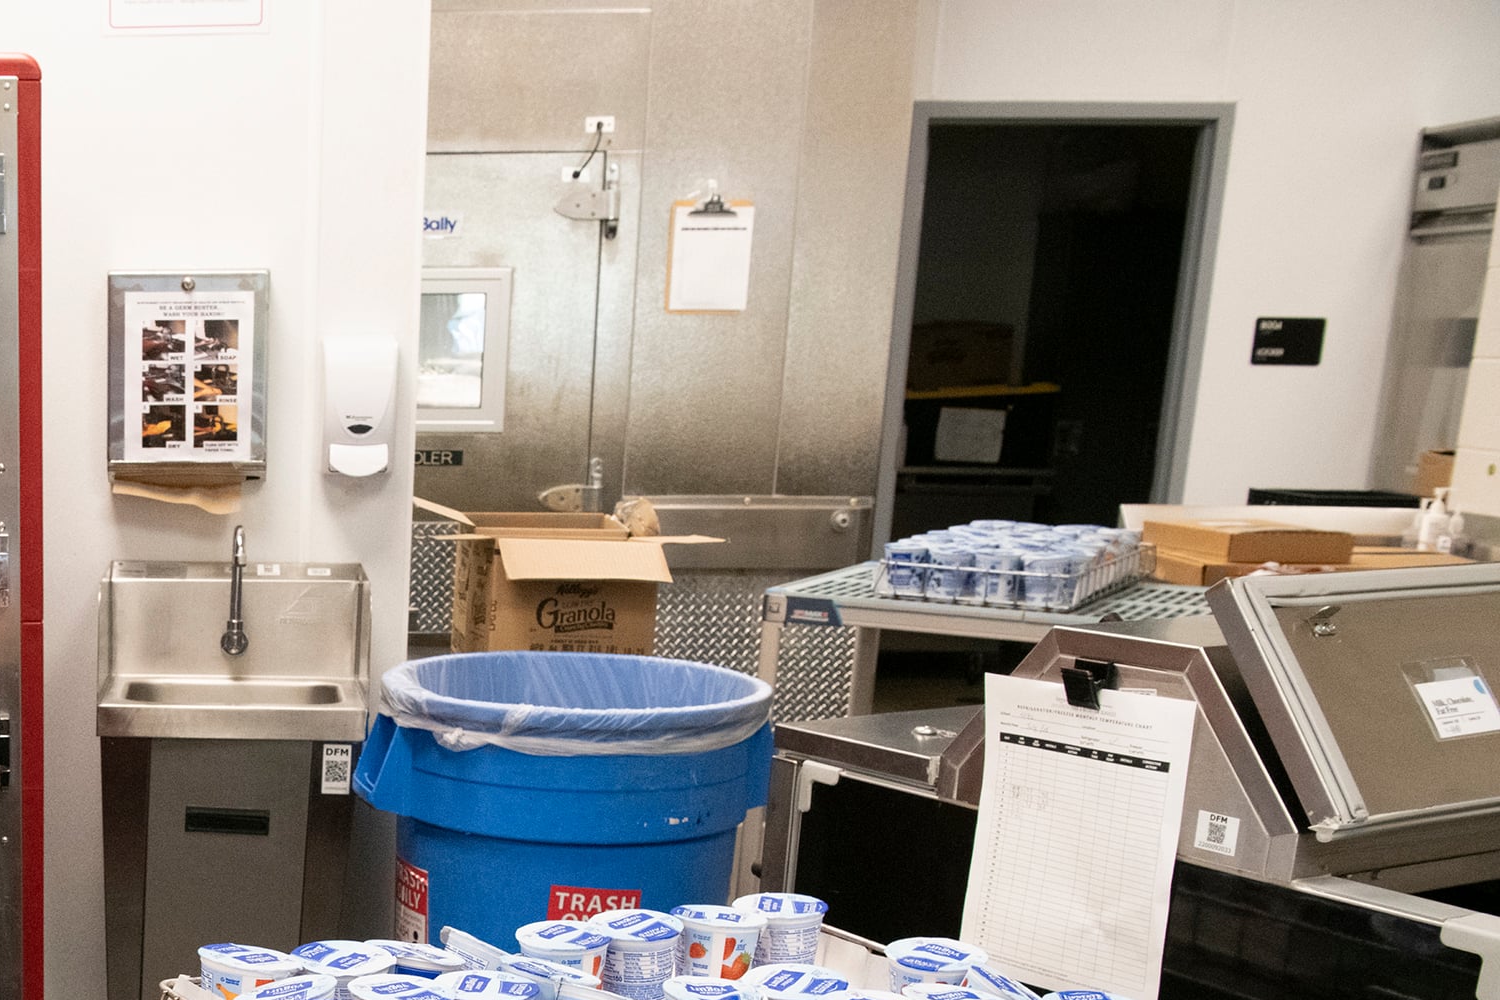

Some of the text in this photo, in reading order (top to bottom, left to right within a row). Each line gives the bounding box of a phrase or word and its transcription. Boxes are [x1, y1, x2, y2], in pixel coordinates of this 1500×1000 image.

[536, 597, 616, 629] Granola
[325, 747, 350, 757] DFM
[1210, 813, 1228, 824] DFM
[555, 891, 637, 913] TRASH
